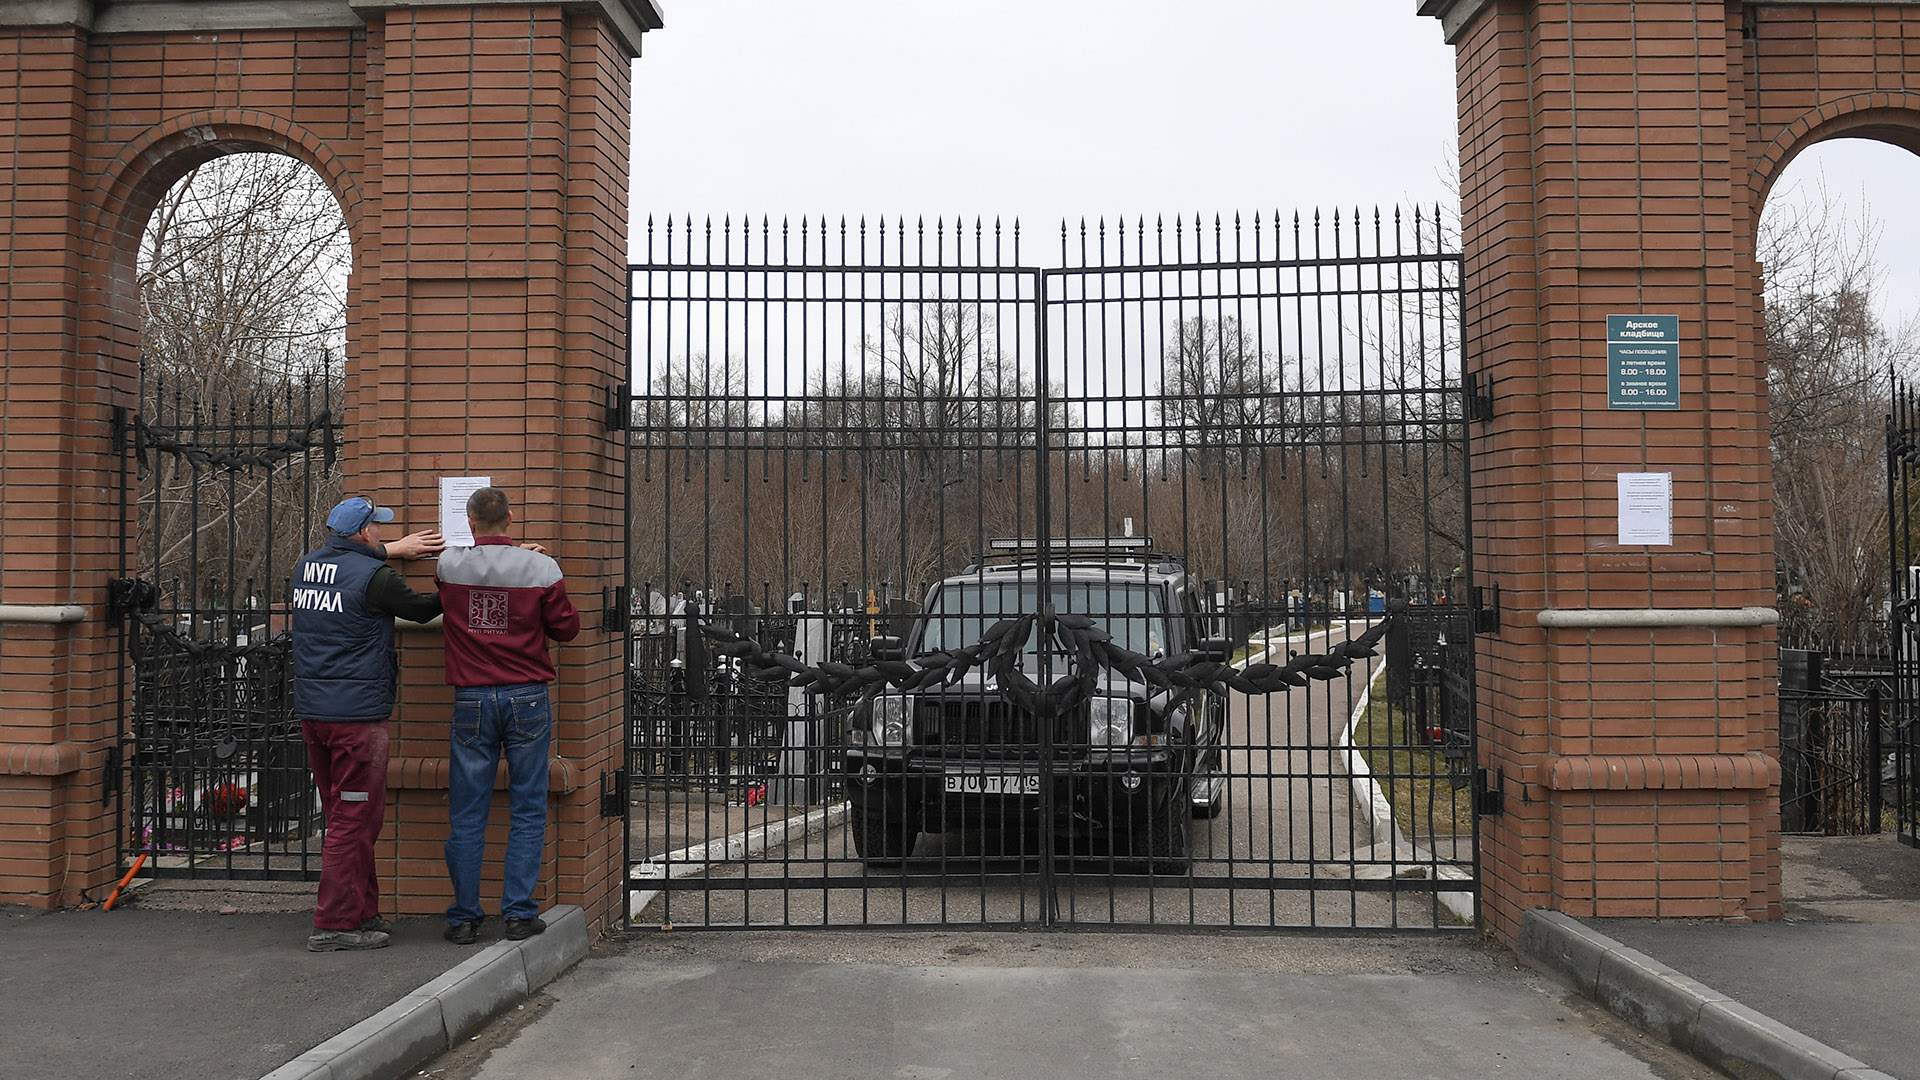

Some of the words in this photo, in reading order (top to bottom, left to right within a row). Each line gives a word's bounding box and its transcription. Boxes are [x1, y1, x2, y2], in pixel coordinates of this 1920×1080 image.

[1626, 321, 1658, 330] Арское
[1620, 330, 1664, 338] кладбище
[303, 561, 338, 585] МУП
[293, 588, 343, 613] РИТУАЛ
